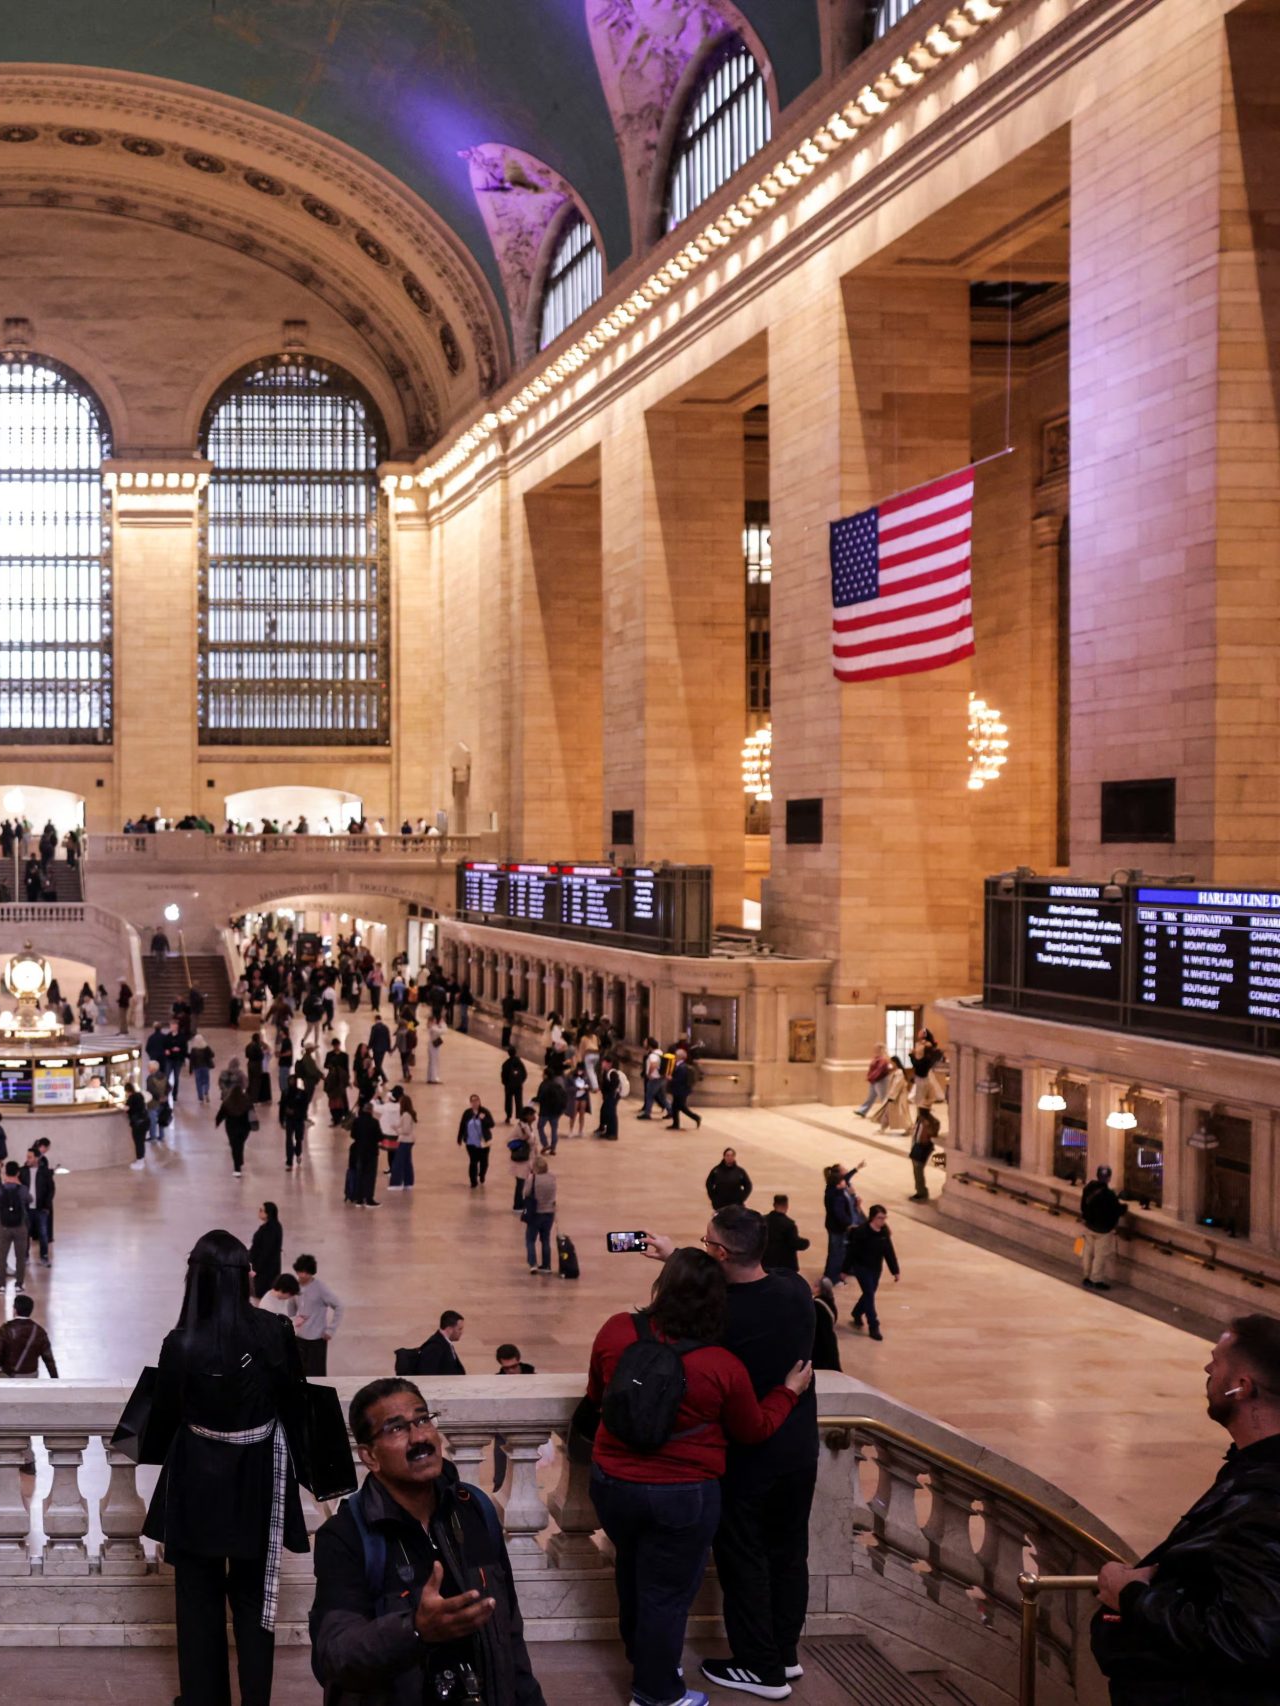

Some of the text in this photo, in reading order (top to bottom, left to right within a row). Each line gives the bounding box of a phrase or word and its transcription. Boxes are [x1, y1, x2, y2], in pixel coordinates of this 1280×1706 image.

[1050, 886, 1100, 898] INFORMATION
[1198, 891, 1242, 906] HARLEM
[1243, 893, 1270, 907] LINE
[1140, 911, 1157, 920] TIME
[1162, 912, 1177, 921] TRK
[1183, 913, 1233, 925] DESTINATION
[1183, 927, 1220, 938] SOUTHEAST
[1046, 942, 1062, 951] Grand
[1062, 943, 1079, 953] Central
[1183, 941, 1206, 951] MOUNT
[1206, 943, 1226, 953] KISCO
[1250, 946, 1273, 956] WHITE
[1037, 953, 1052, 962] Thank
[1190, 955, 1211, 966] WHITE
[1212, 958, 1233, 969] PLAINS
[1190, 969, 1211, 980] WHITE
[1212, 972, 1233, 983] PLAINS
[1183, 983, 1220, 995] SOUTHEAST
[1182, 997, 1220, 1009] SOUTHEAST
[1249, 1005, 1271, 1017] WHITE
